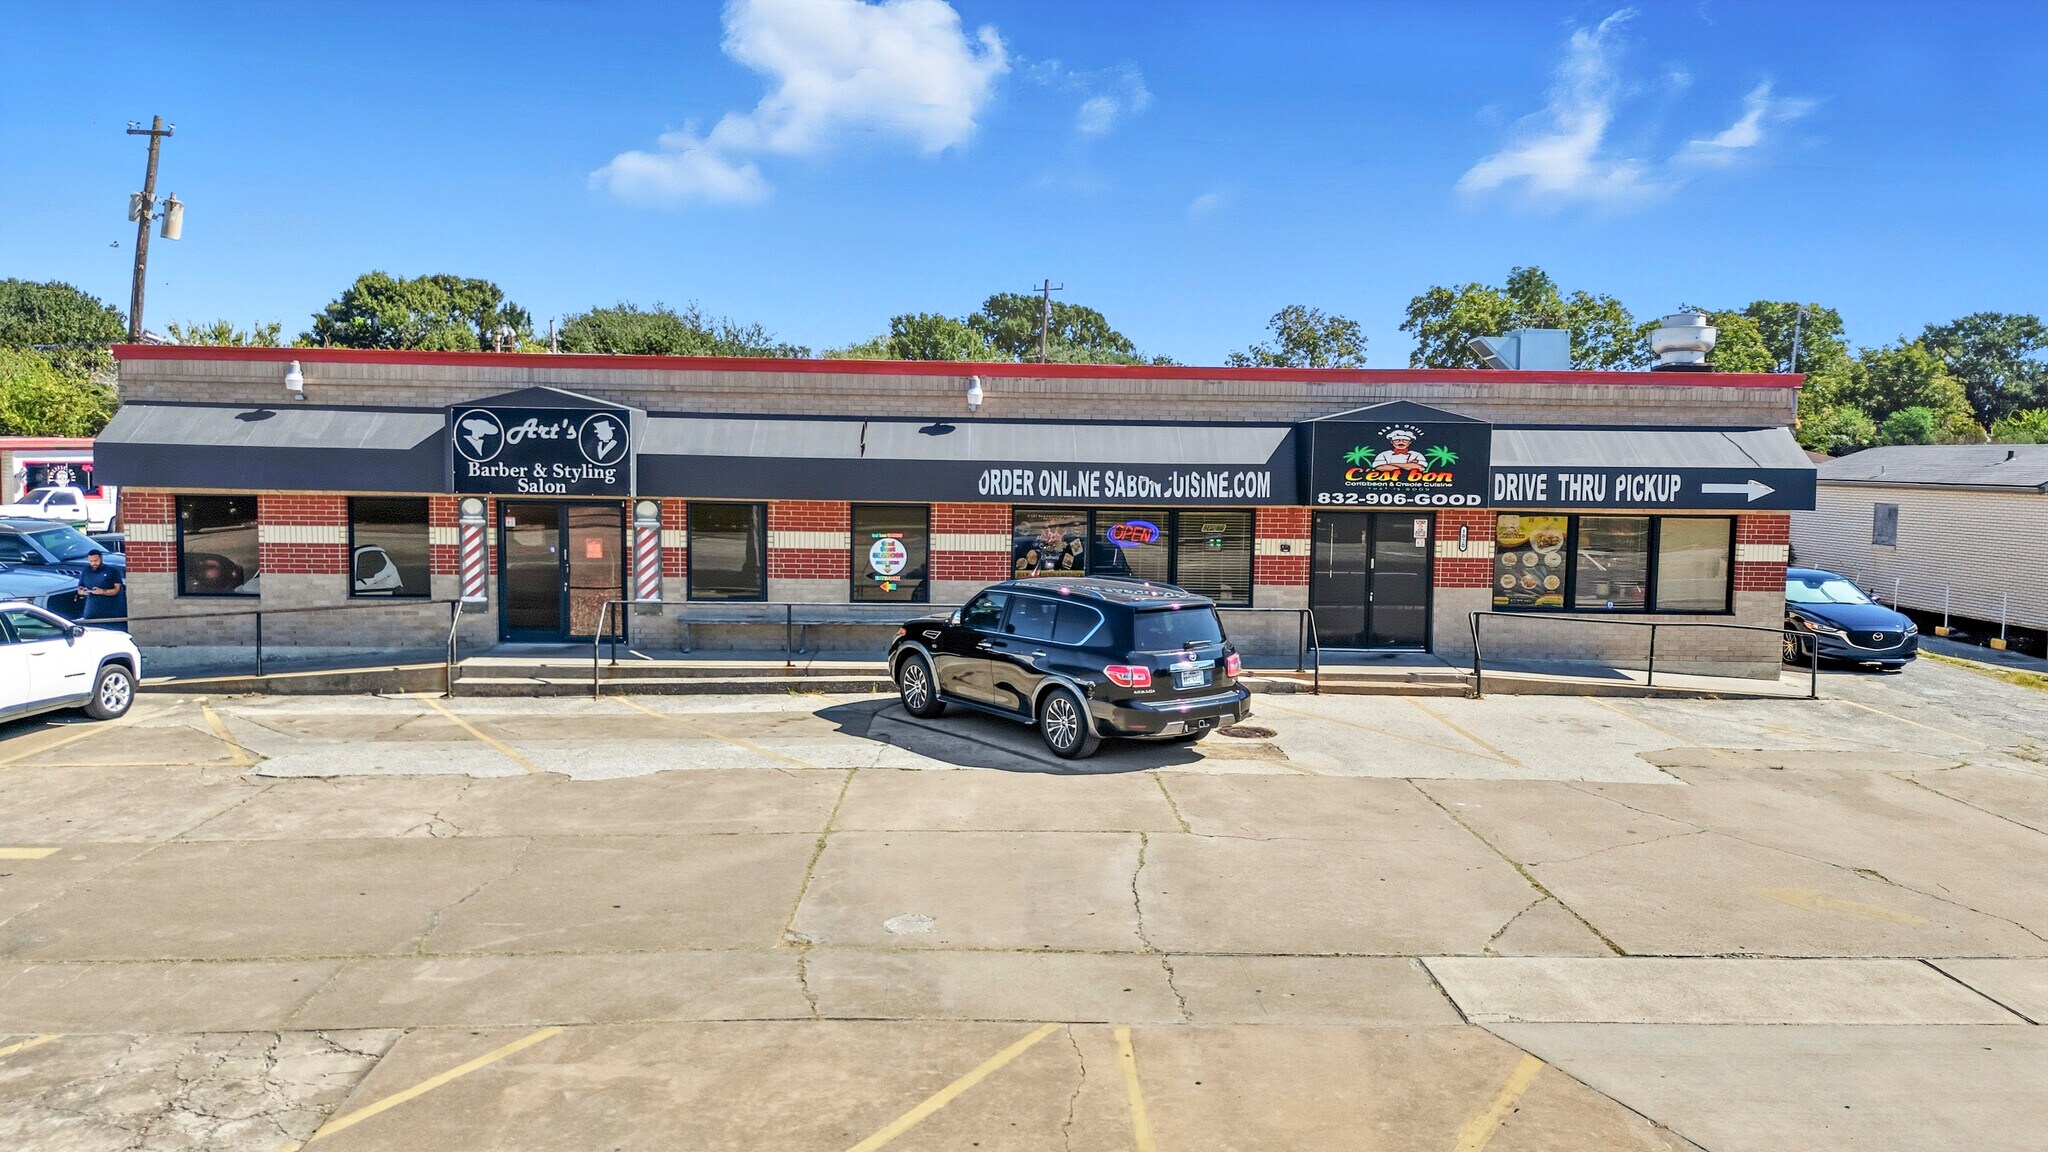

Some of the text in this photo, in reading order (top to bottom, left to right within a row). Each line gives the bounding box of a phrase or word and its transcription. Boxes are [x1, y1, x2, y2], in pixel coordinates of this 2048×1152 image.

[505, 417, 577, 445] Art's
[1404, 424, 1425, 436] GRILL
[467, 461, 617, 484] Barber & Styling
[1345, 467, 1453, 482] C'est bon
[517, 478, 567, 494] Salon
[978, 469, 1035, 496] ORDER
[1494, 473, 1681, 502] DRIVE THRU PICKUP
[1317, 492, 1482, 506] 832-906-GOOD
[1112, 524, 1152, 543] OPEN
